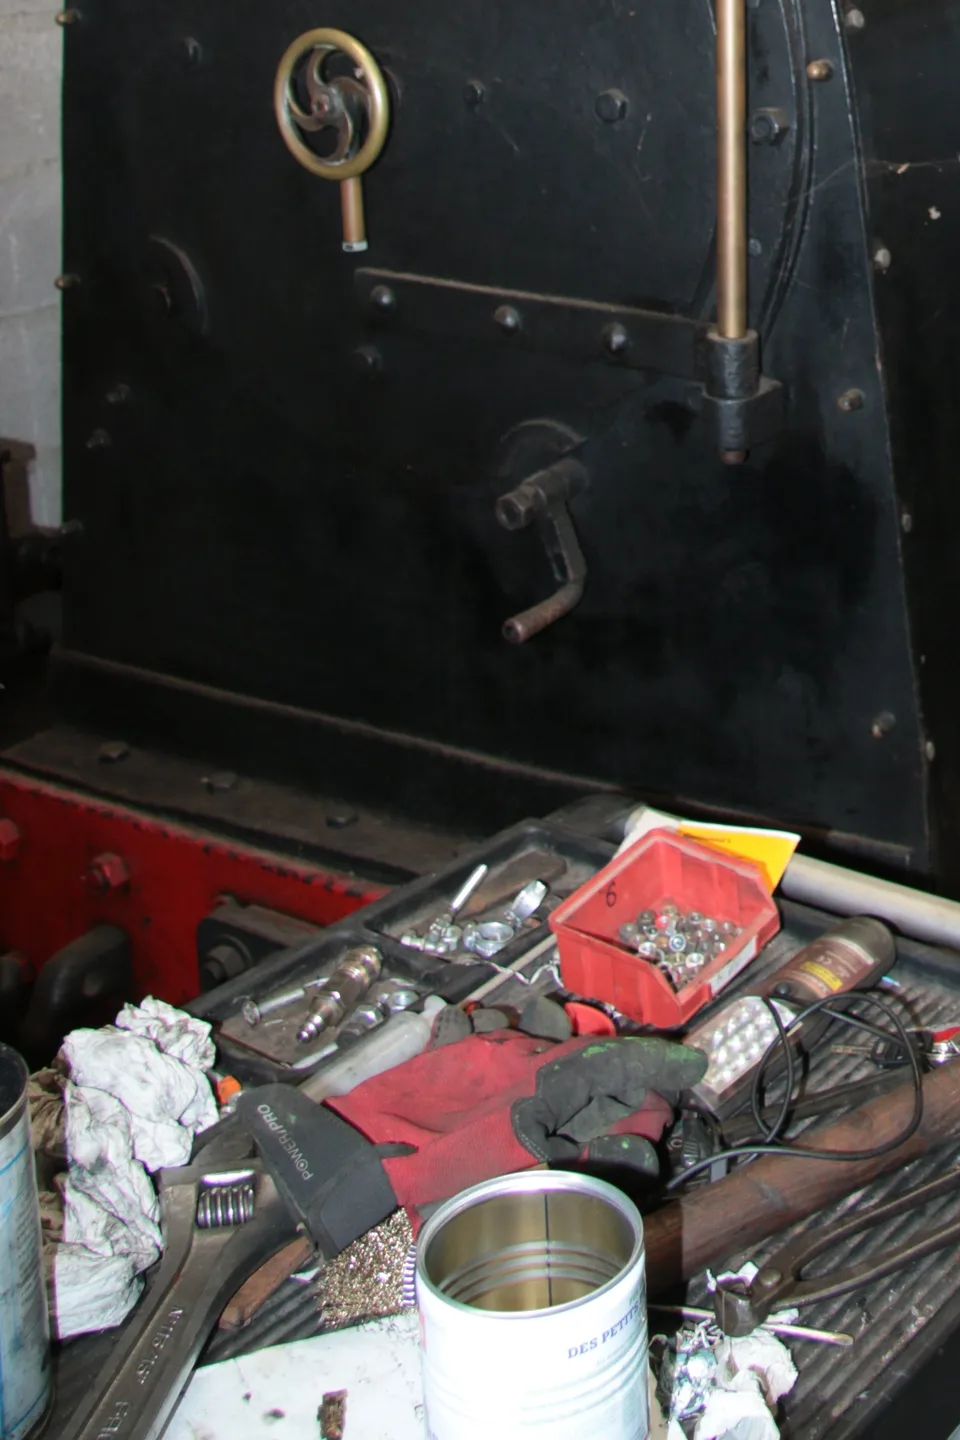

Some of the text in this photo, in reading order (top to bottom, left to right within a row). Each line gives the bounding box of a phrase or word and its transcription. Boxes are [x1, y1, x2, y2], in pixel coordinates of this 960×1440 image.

[605, 880, 617, 908] 6
[567, 1301, 639, 1359] DES PETITS
